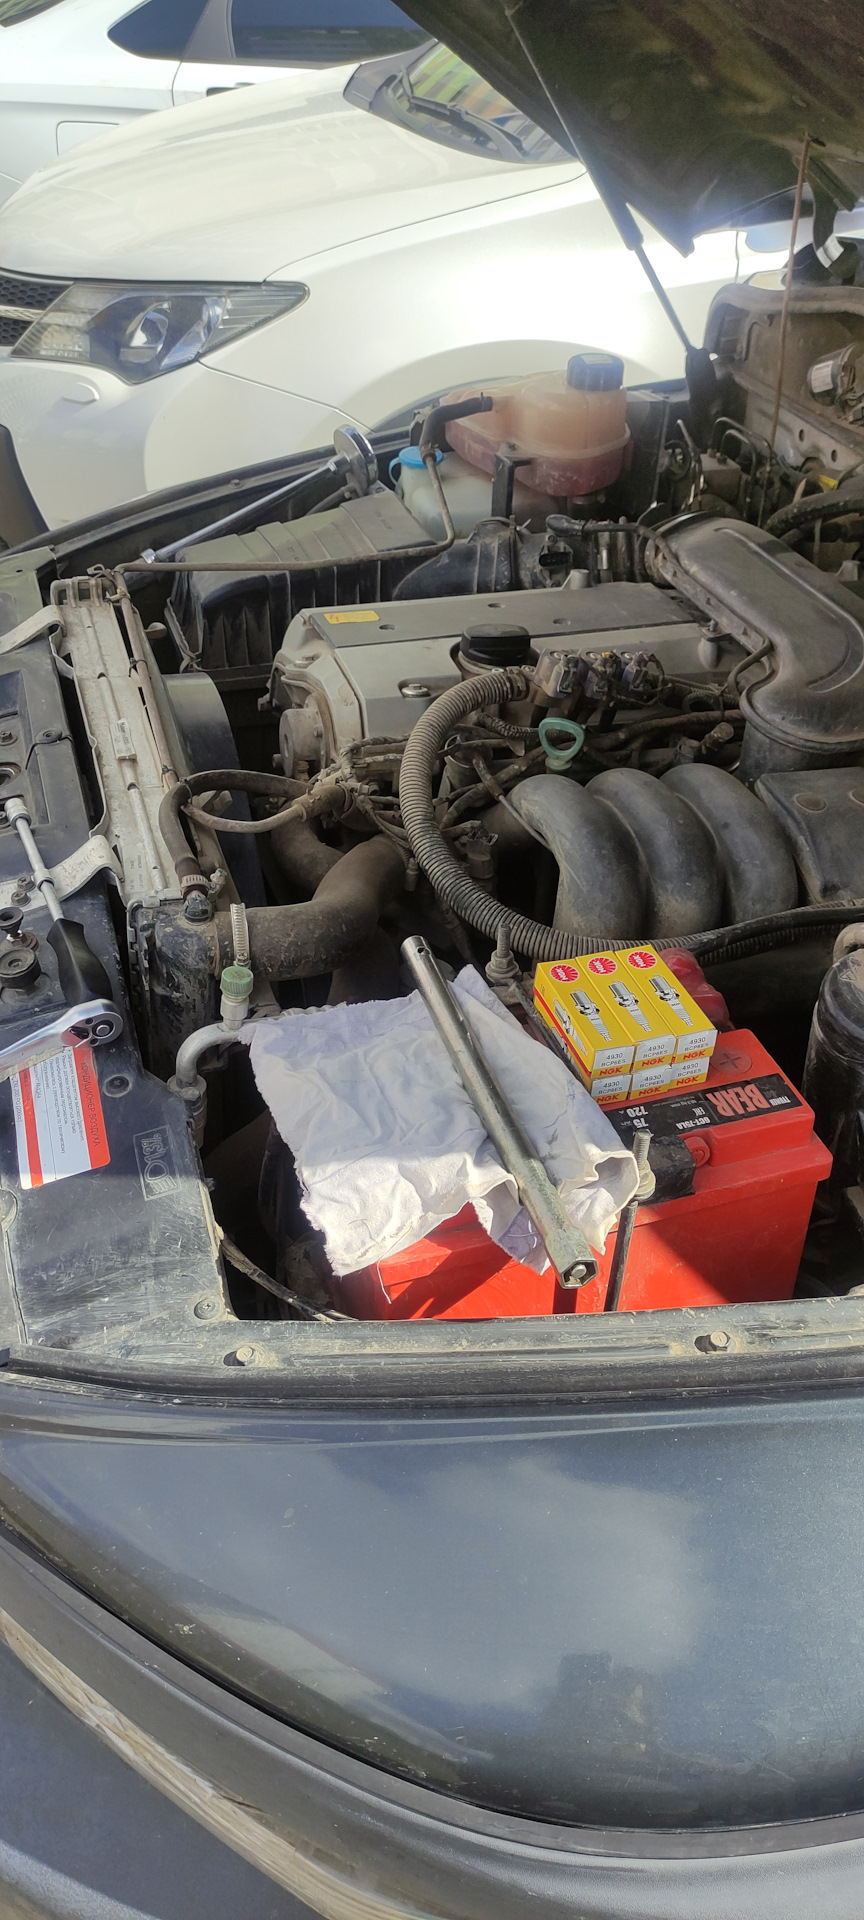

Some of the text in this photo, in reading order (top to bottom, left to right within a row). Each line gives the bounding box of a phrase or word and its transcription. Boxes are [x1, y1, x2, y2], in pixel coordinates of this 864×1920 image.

[633, 954, 646, 967] NGK
[593, 960, 606, 973] NGK
[556, 967, 568, 981] NGK
[689, 1037, 706, 1045] 4930
[648, 1044, 665, 1052] 4930
[606, 1053, 623, 1061] 4930
[683, 1050, 706, 1061] NGK
[642, 1057, 665, 1067] NGK
[682, 1063, 699, 1071] 4930
[600, 1066, 623, 1076] NGK
[603, 1081, 620, 1089] 4930
[676, 1076, 699, 1086] NGK
[638, 1087, 661, 1097] NGK
[597, 1094, 620, 1104] NGK
[705, 1083, 771, 1117] BEAR
[80, 1062, 101, 1147] КОНДИЦИОНЕР ВОЗДУХА
[626, 1106, 648, 1118] 720
[632, 1117, 649, 1128] 75
